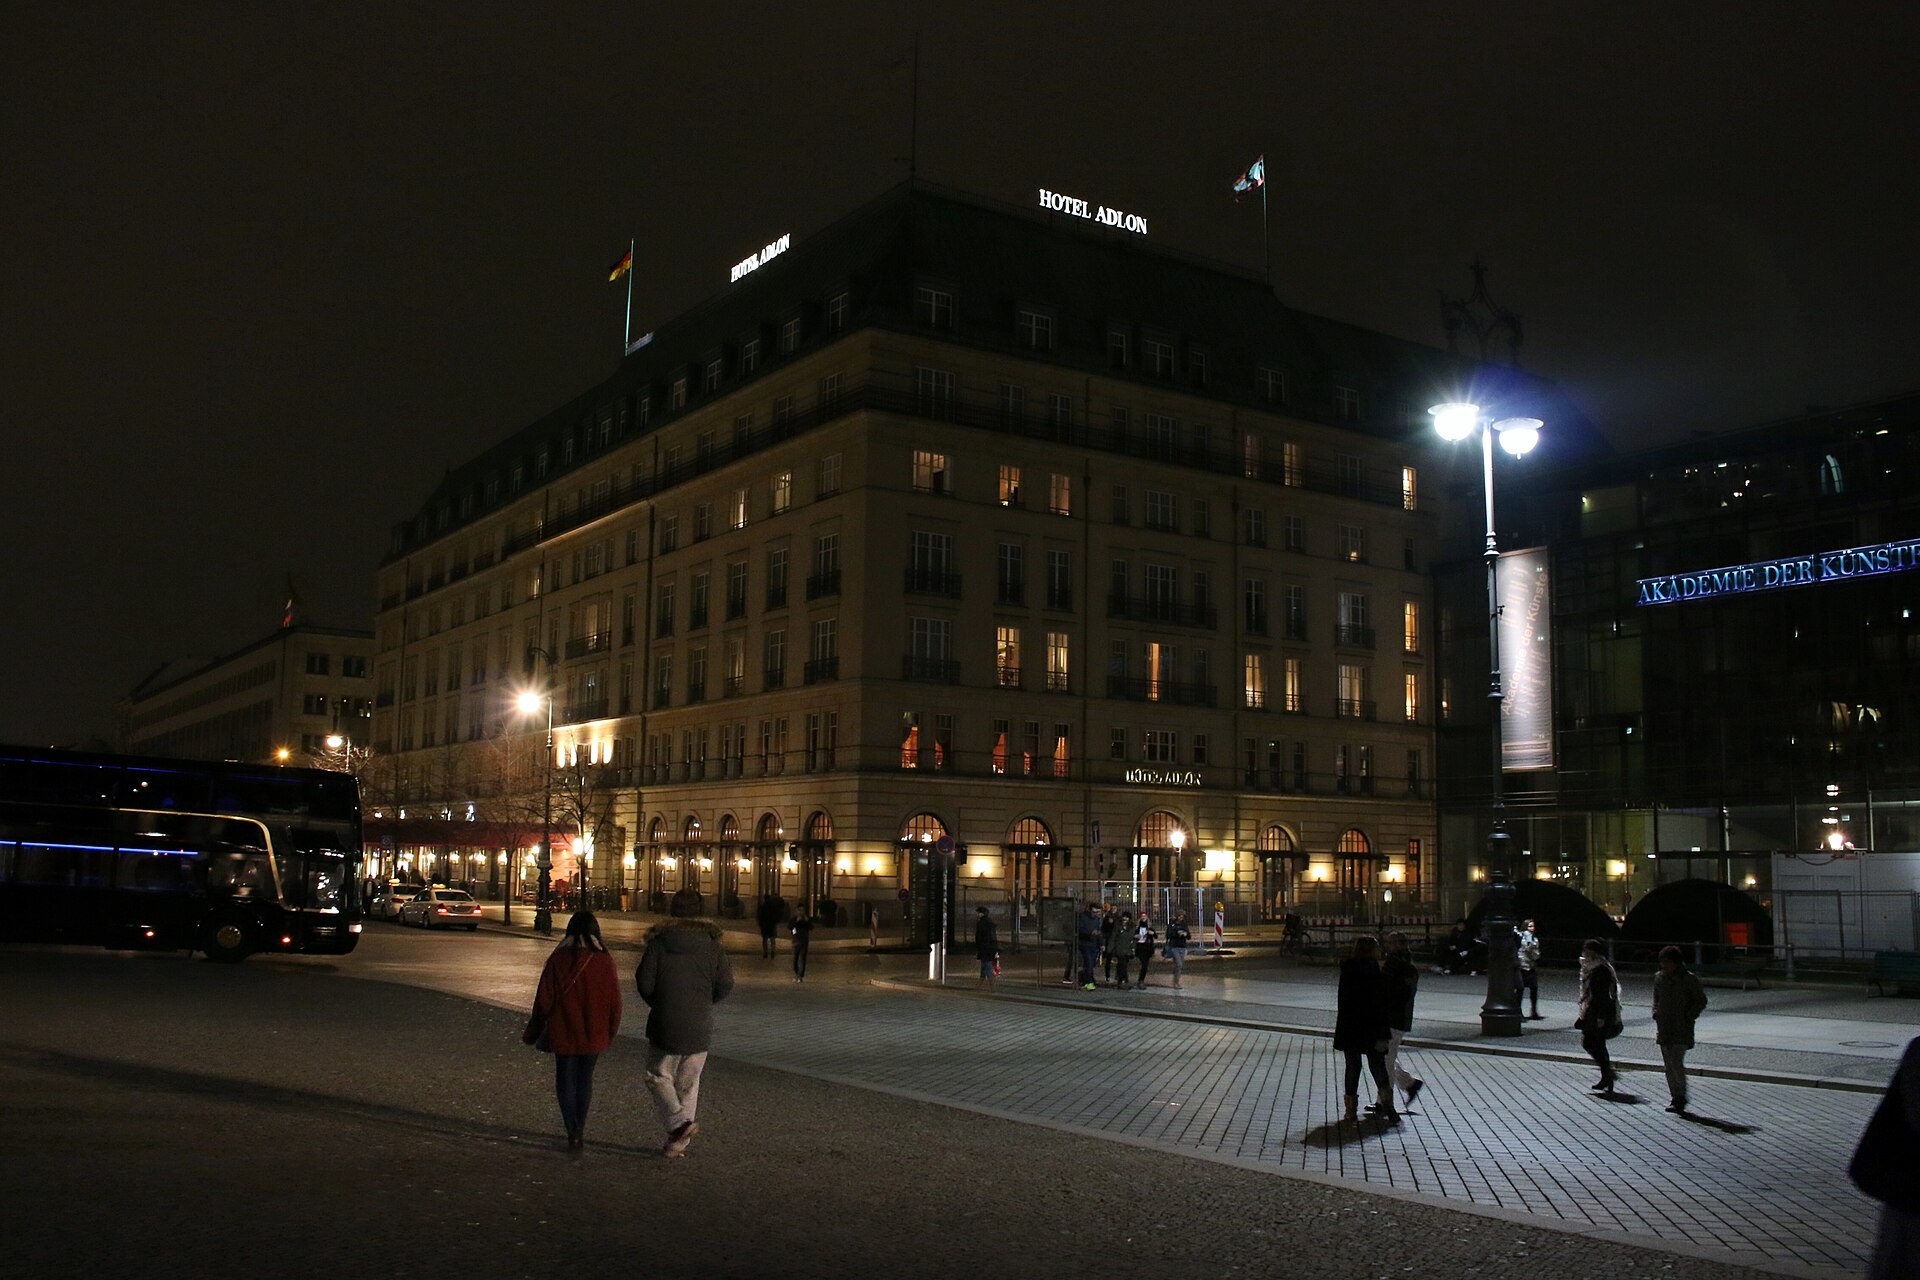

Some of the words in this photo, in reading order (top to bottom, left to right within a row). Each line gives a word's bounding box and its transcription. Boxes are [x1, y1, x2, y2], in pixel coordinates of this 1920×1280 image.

[1039, 188, 1092, 219] HOTEL
[1095, 205, 1148, 235] ADLON
[731, 253, 760, 283] HOTEL
[760, 233, 790, 266] ADLON
[1526, 572, 1548, 622] Künste
[1638, 568, 1756, 603] AKADEMIE
[1763, 561, 1813, 586] DER
[1522, 622, 1535, 647] der
